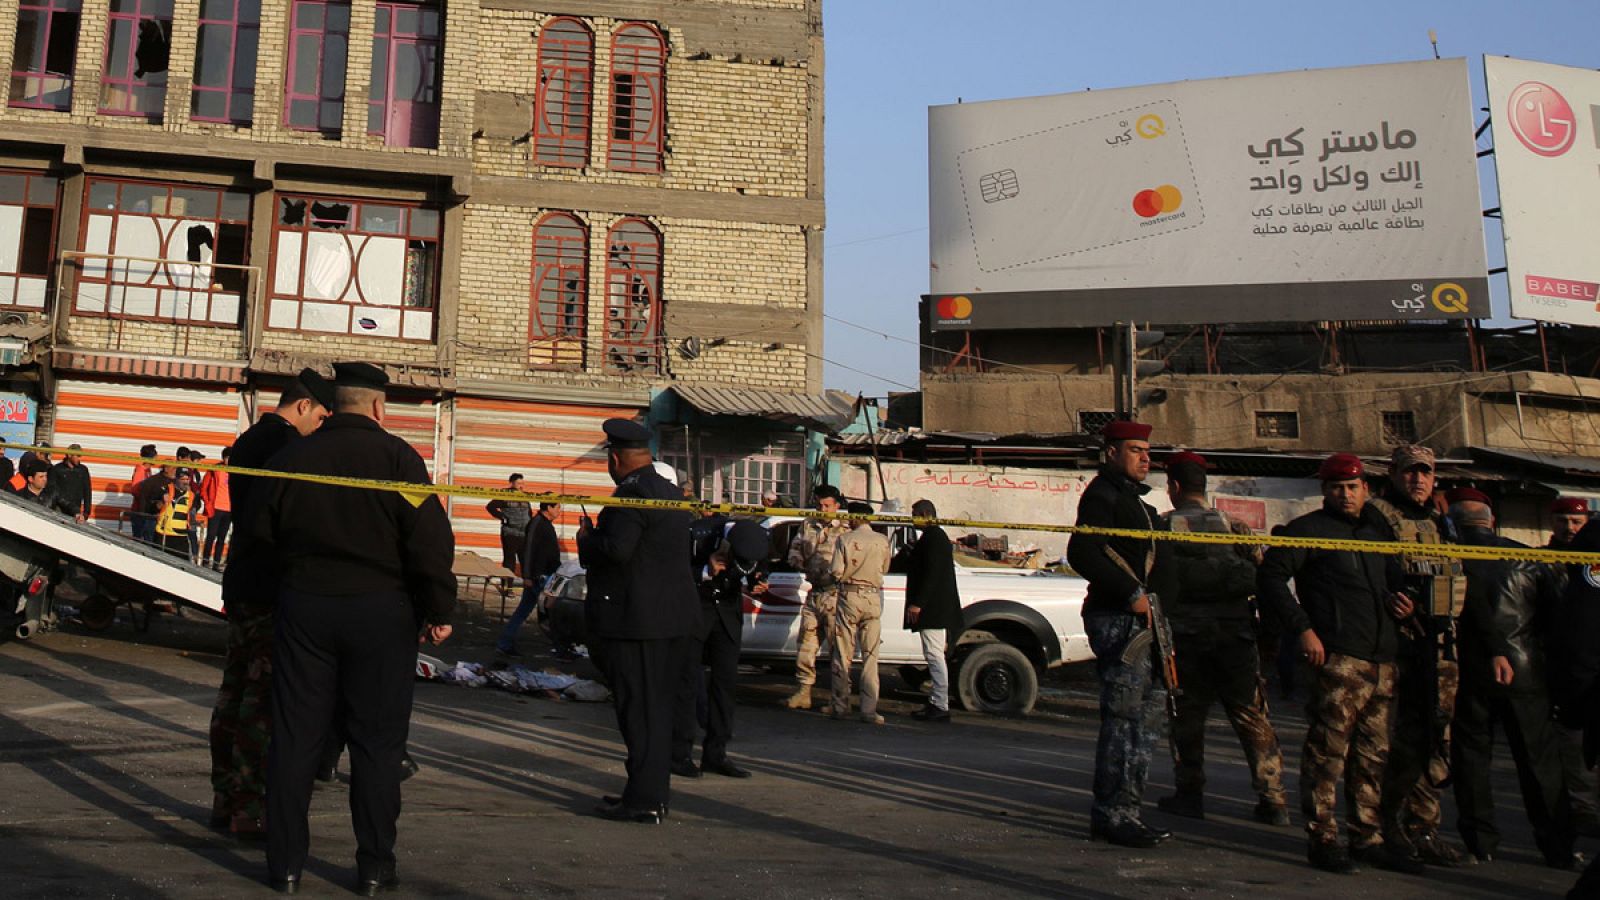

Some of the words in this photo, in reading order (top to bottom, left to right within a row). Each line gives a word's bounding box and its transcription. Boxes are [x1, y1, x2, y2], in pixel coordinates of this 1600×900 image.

[1512, 86, 1572, 152] LG
[1318, 120, 1417, 162] ماستر
[1249, 168, 1303, 195] واحد
[1312, 164, 1369, 193] ولكل
[1379, 160, 1424, 189] إلك
[1278, 202, 1324, 217] بطاقات
[1328, 203, 1347, 216] من
[1351, 198, 1387, 214] الثالث
[1391, 197, 1424, 214] الجيل
[1139, 211, 1186, 228] mastercard
[1338, 217, 1380, 233] عالمية
[1384, 216, 1425, 230] بطاقة
[1252, 223, 1288, 237] محلية
[1292, 221, 1333, 236] بتعرفة
[1527, 279, 1595, 298] BABEL
